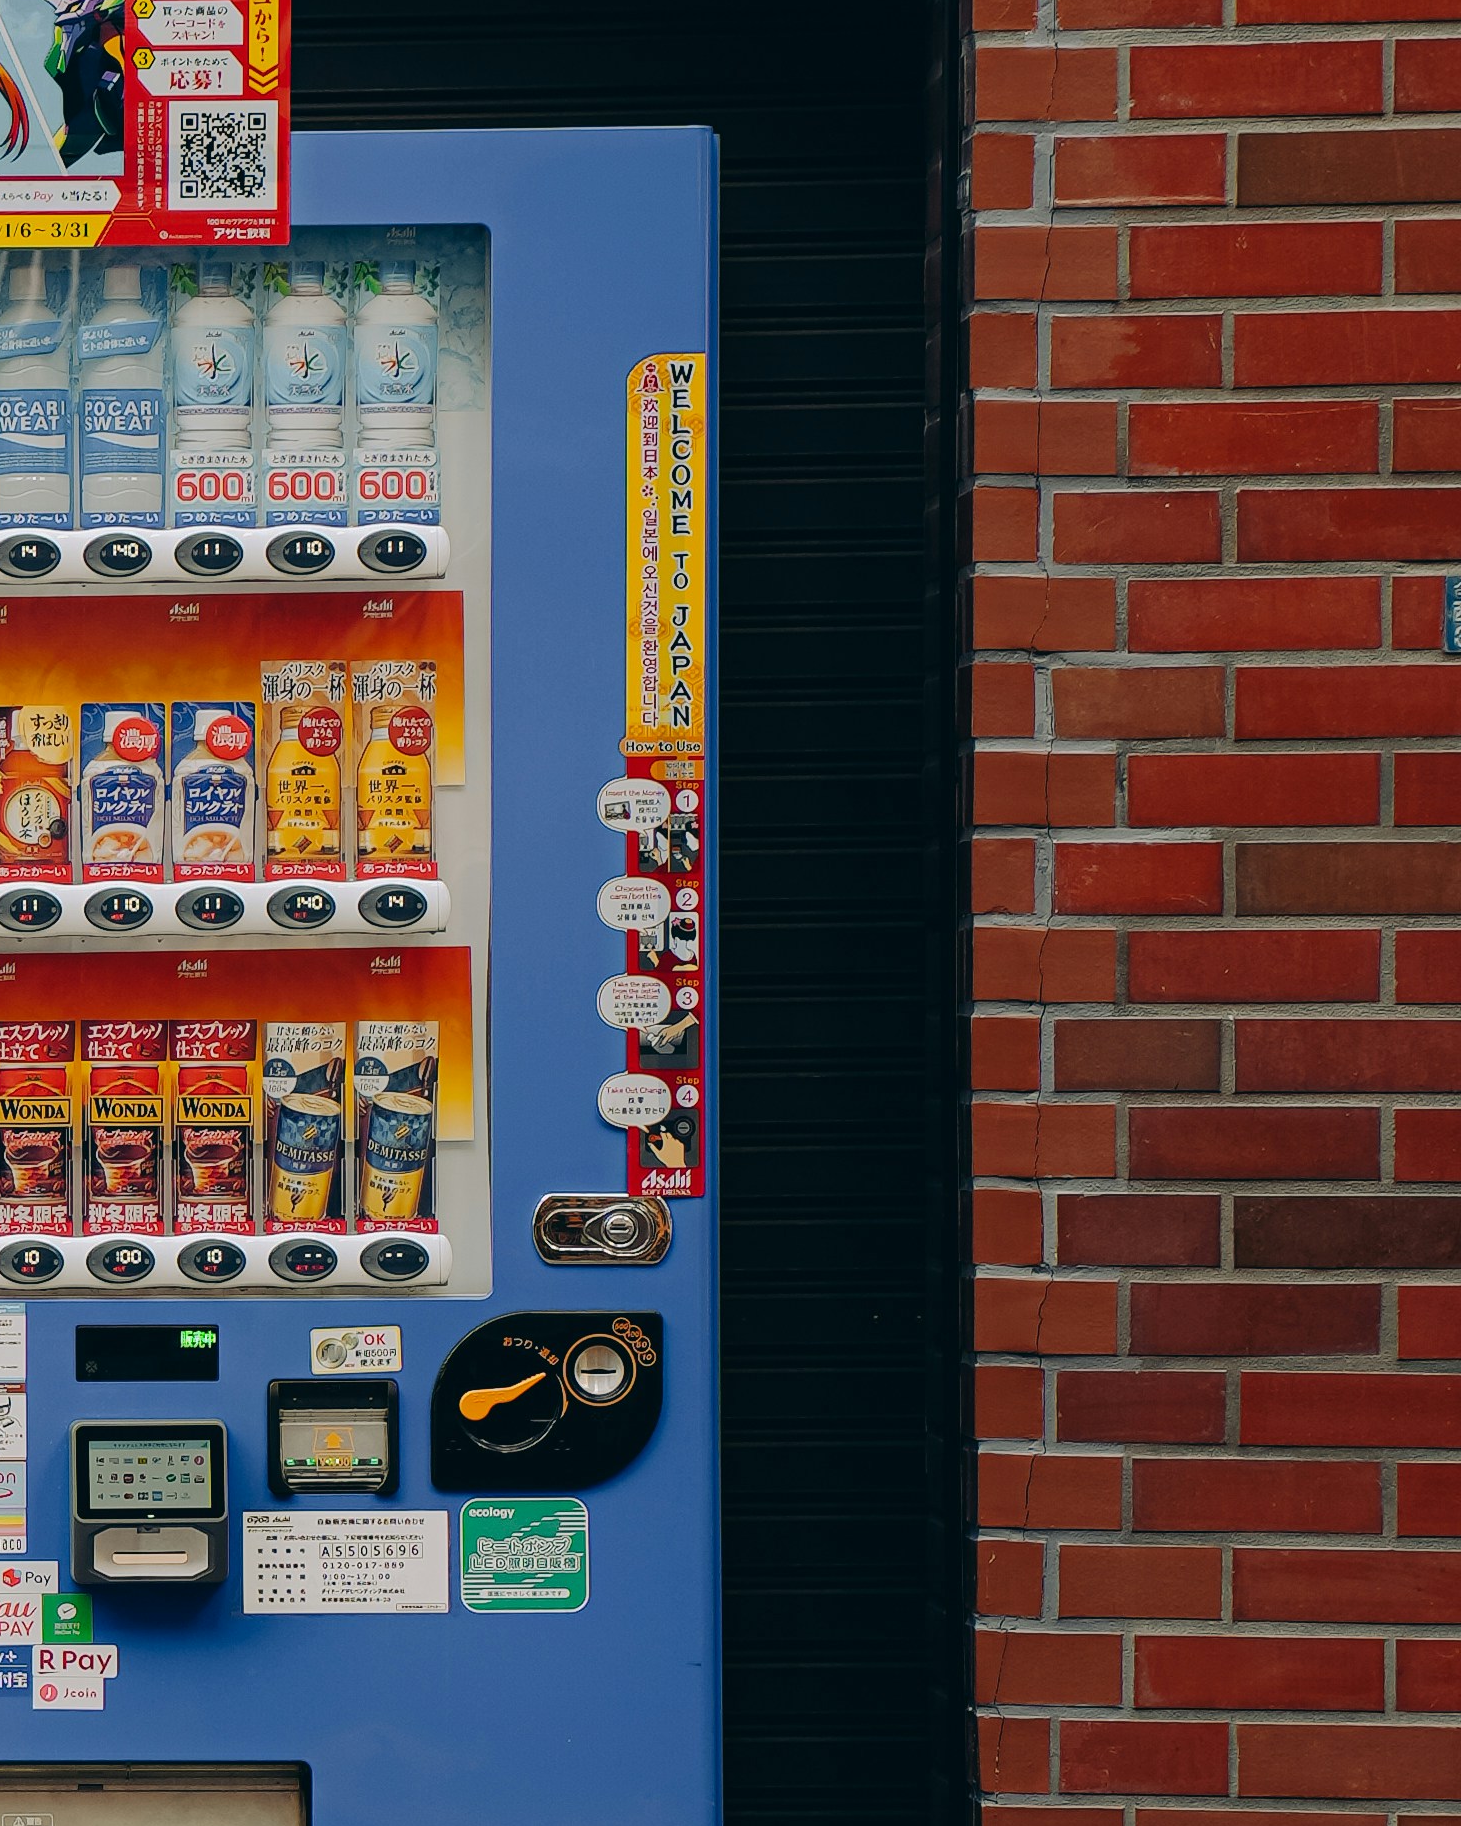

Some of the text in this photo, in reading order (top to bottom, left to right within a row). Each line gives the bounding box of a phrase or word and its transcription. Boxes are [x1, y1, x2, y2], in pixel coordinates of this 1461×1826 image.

[139, 1, 148, 14] 2
[162, 6, 228, 16] 買った商品の
[165, 19, 226, 28] バーコードを
[139, 52, 148, 65] 3
[160, 58, 229, 66] ポイントをためて
[213, 228, 271, 240] アサヒ飲料
[84, 401, 159, 417] POCARI
[84, 415, 153, 431] SWEAT
[641, 397, 659, 482] 欢迎到日本
[180, 454, 249, 466] とぎ澄まされた水
[177, 473, 244, 502] 600
[268, 472, 336, 501] 600
[359, 471, 427, 501] 600
[669, 363, 694, 728] WELCOME TO JAPAN
[281, 663, 325, 677] バリスタ
[263, 673, 346, 702] 渾身の一杯
[119, 729, 158, 751] 濃厚
[625, 740, 701, 753] How to Use
[675, 781, 699, 790] Step
[95, 788, 150, 801] ロイヤル
[683, 795, 690, 807] 1
[92, 801, 153, 816] ミルクティー
[675, 879, 699, 888] Step
[682, 893, 692, 907] 2
[676, 978, 699, 987] Step
[682, 991, 693, 1006] 3
[276, 1026, 335, 1037] 甘さに頼らない
[266, 1037, 343, 1053] 最高峰のコク
[676, 1076, 699, 1085] Step
[681, 1090, 693, 1103] 4
[94, 1098, 158, 1119] WONDA
[178, 1097, 245, 1119] WONDA
[276, 1142, 335, 1163] DEMITASSE
[367, 1140, 427, 1162] DEMITASSE
[641, 1169, 691, 1189] Asahi
[180, 1330, 217, 1349] 販売中
[364, 1333, 386, 1345] OK
[469, 1506, 515, 1520] ecology
[477, 1536, 572, 1555] ヒートポンプ
[25, 1572, 51, 1587] Pay
[63, 1651, 112, 1672] Pay
